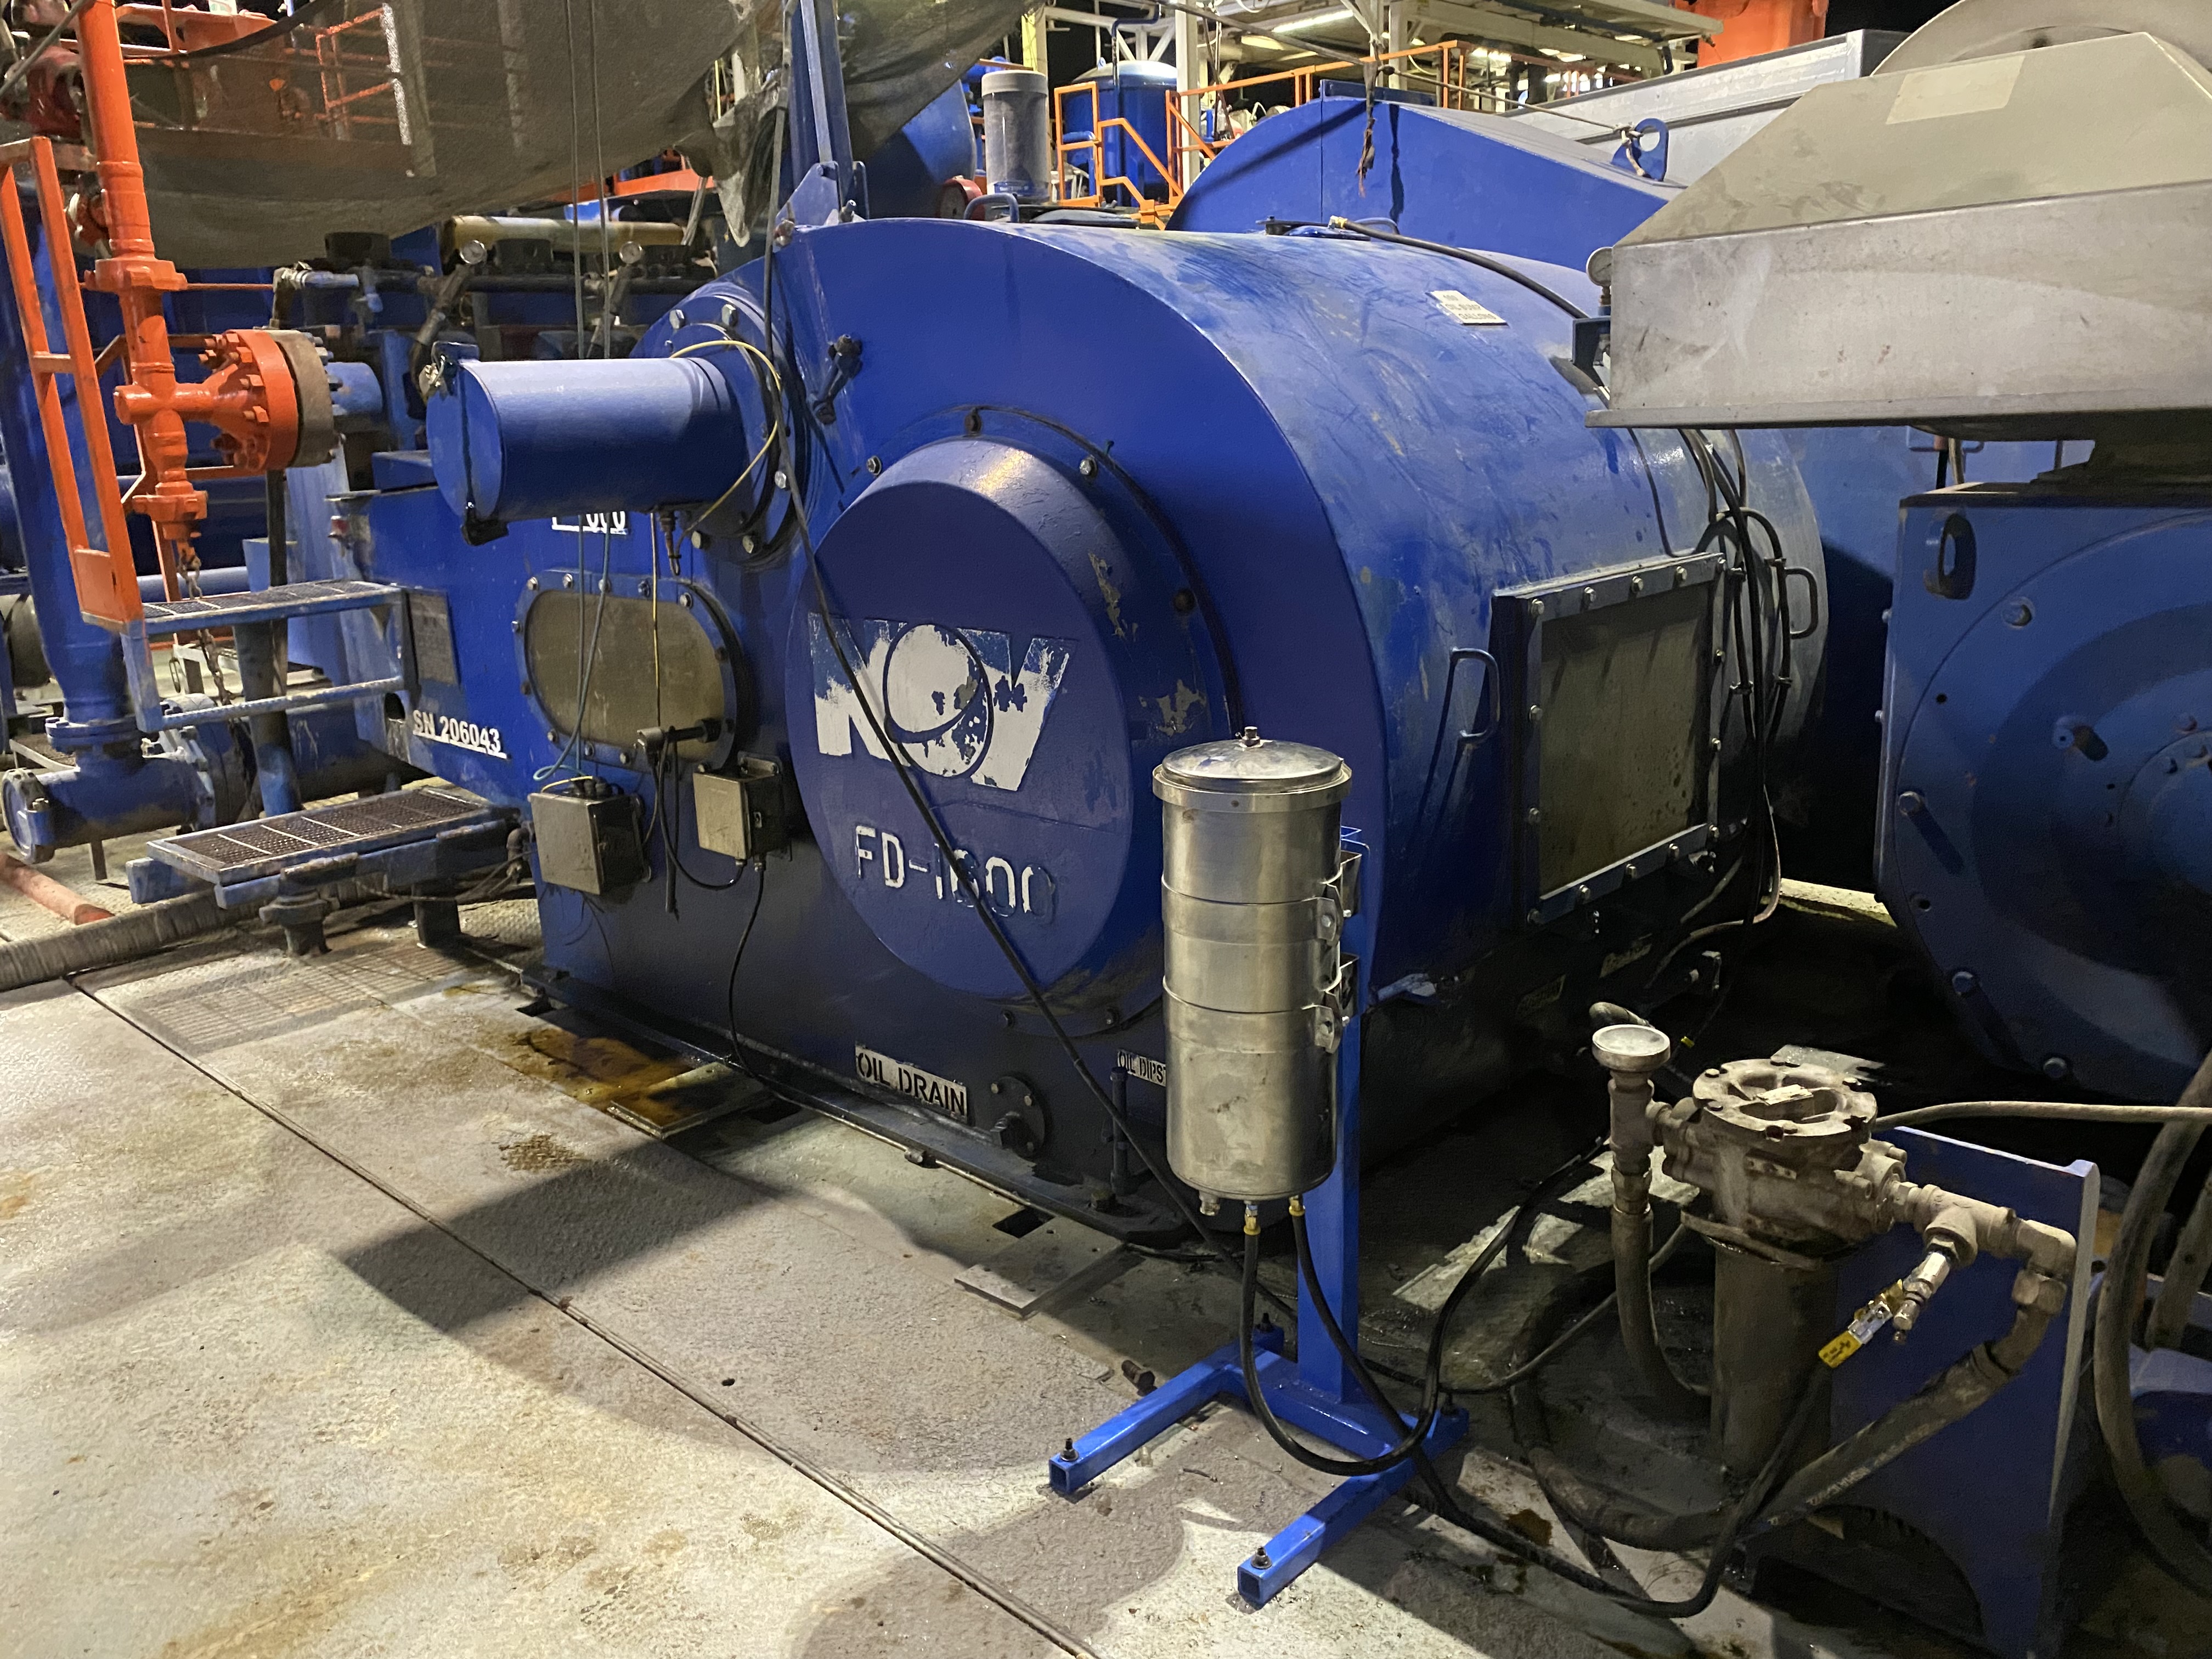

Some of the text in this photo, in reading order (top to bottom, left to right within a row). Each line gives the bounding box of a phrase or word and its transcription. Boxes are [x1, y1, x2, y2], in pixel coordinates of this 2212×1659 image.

[808, 612, 1076, 791] NOV
[413, 709, 501, 753] SN 206043
[857, 1052, 965, 1116] OIL DRAIN
[1119, 1051, 1166, 1083] OIL DIPS
